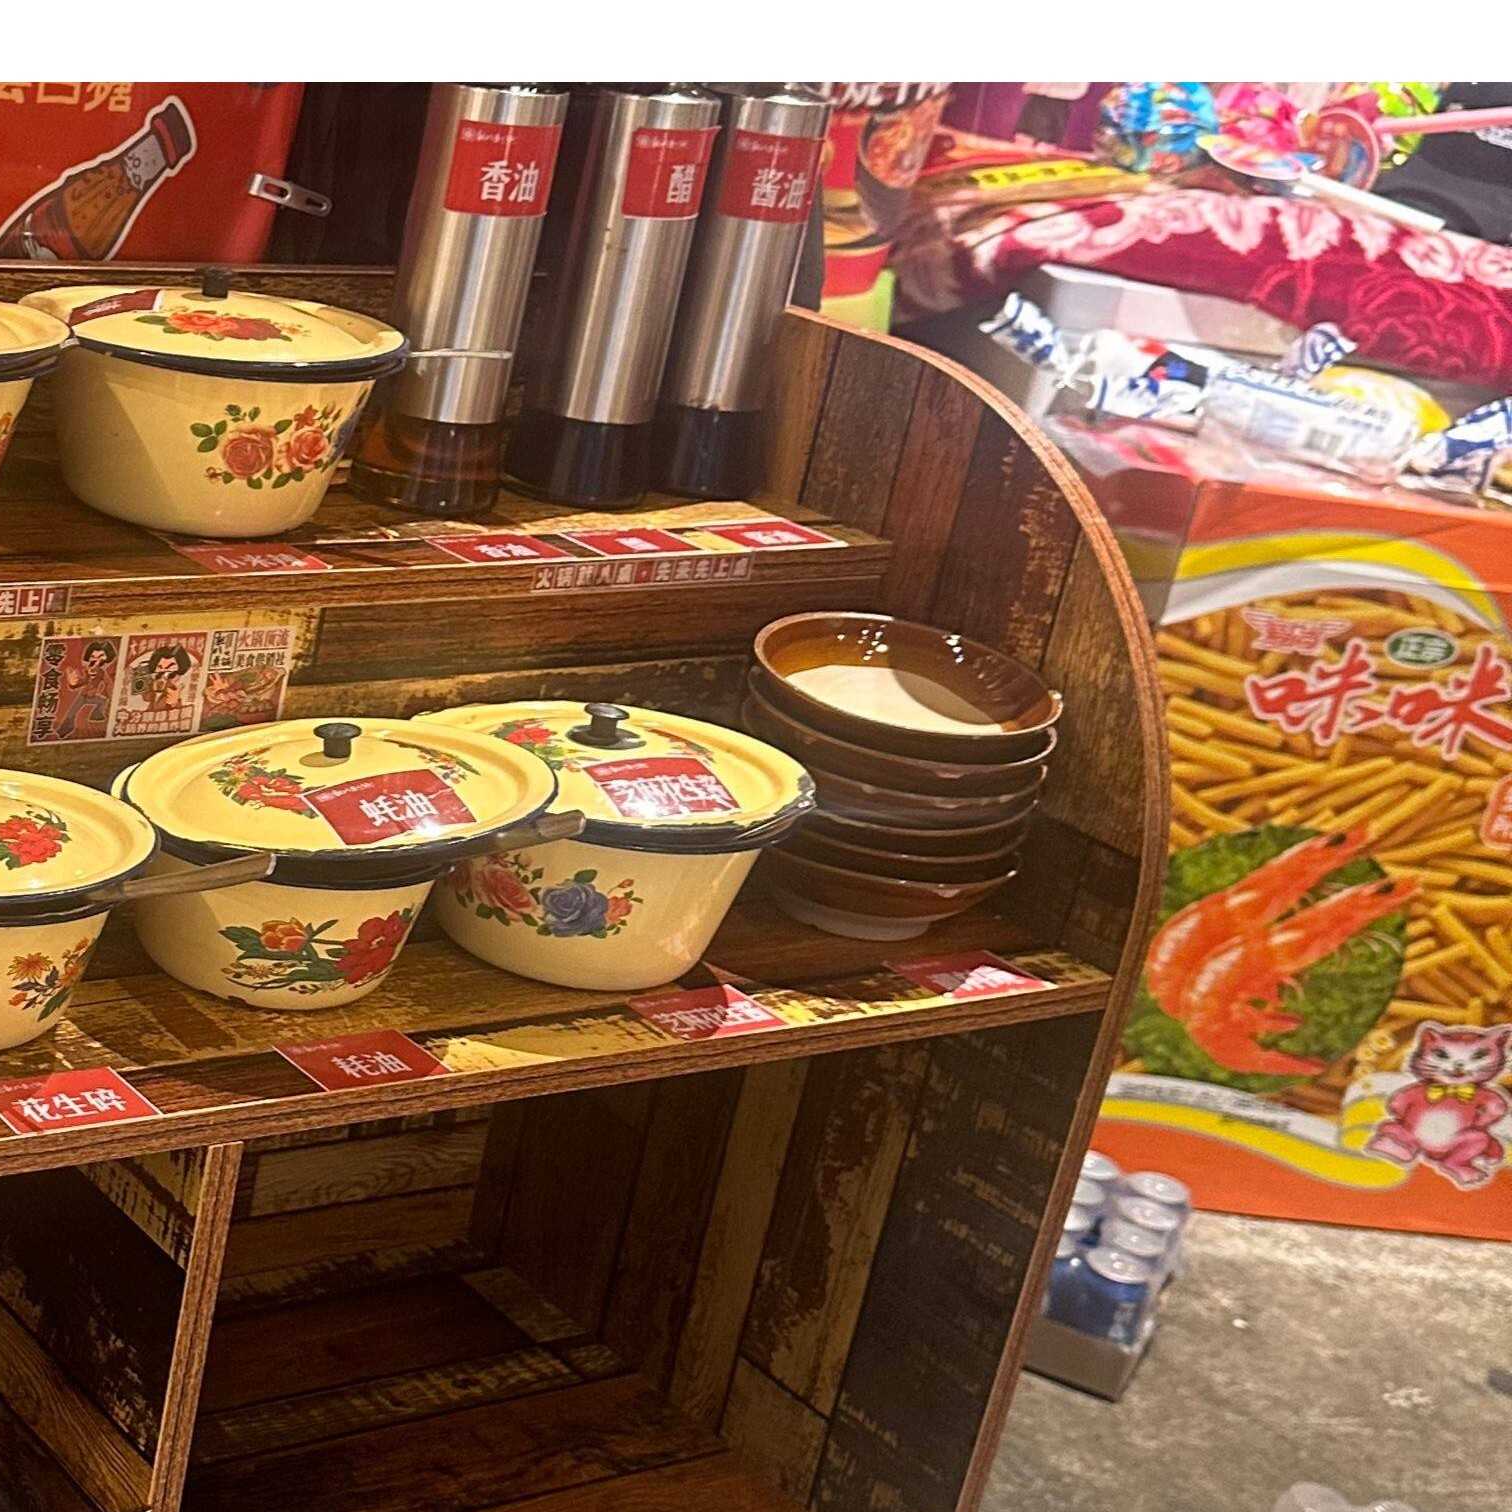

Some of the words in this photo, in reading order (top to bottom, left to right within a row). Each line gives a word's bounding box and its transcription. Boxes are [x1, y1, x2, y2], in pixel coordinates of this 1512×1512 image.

[479, 159, 540, 203] 香油
[665, 163, 697, 204] 醋
[749, 167, 808, 210] 酱油
[359, 789, 440, 827] 蚝油
[331, 1050, 413, 1079] 耗油
[12, 1087, 127, 1123] 花生碎
